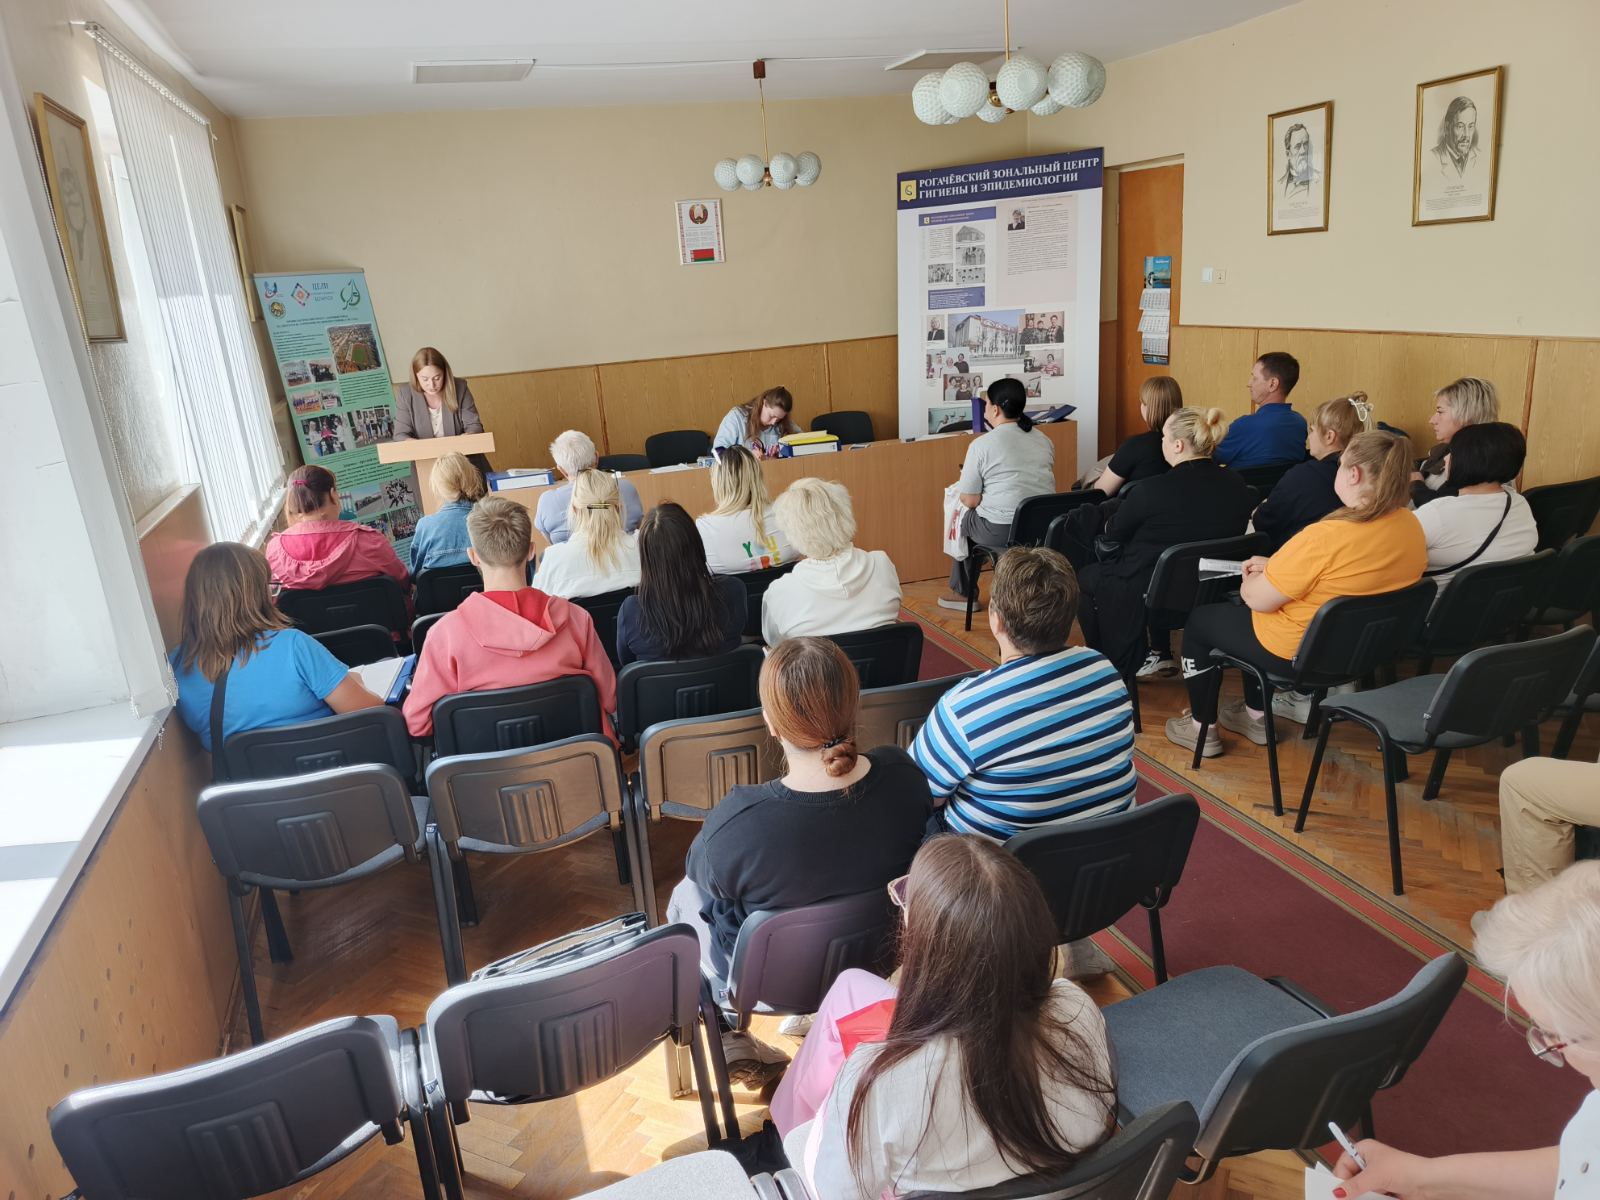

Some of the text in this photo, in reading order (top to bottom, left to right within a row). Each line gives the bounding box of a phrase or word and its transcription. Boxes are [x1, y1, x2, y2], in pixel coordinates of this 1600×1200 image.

[919, 157, 1100, 188] РОГАЧЁВСКИЙ ЗОНАЛЬНЫЙ ЦЕНТР
[919, 173, 1079, 199] ГИГИЕНЫ И ЭПИДЕМИОЛОГИИ
[1181, 656, 1197, 673] KE
